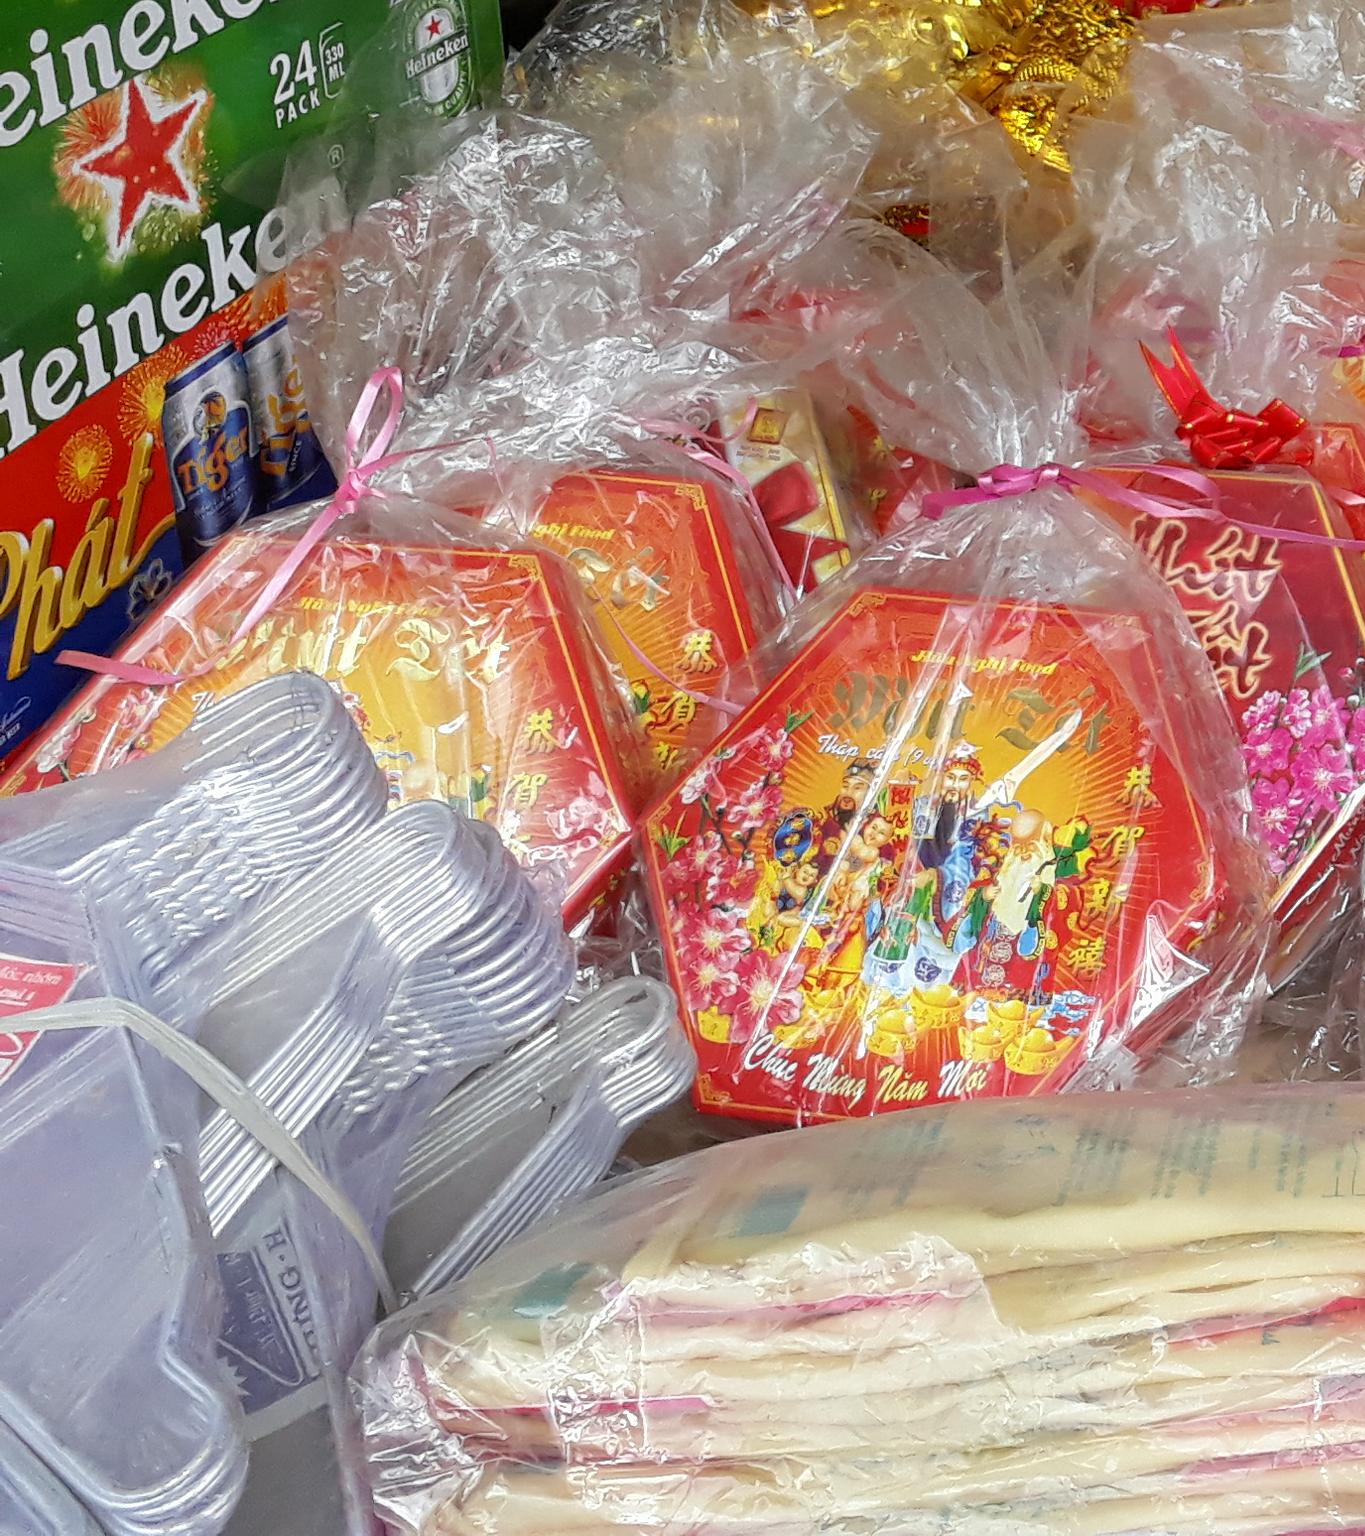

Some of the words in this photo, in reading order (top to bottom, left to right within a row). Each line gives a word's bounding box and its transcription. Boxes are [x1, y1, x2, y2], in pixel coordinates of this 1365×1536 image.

[270, 41, 319, 104] 24
[324, 43, 345, 65] 330
[328, 61, 346, 82] ML
[406, 34, 469, 78] Heineken
[275, 94, 321, 130] PACK
[743, 1033, 799, 1083] Chúc
[877, 1064, 929, 1104] Năm
[937, 1056, 990, 1098] Mới
